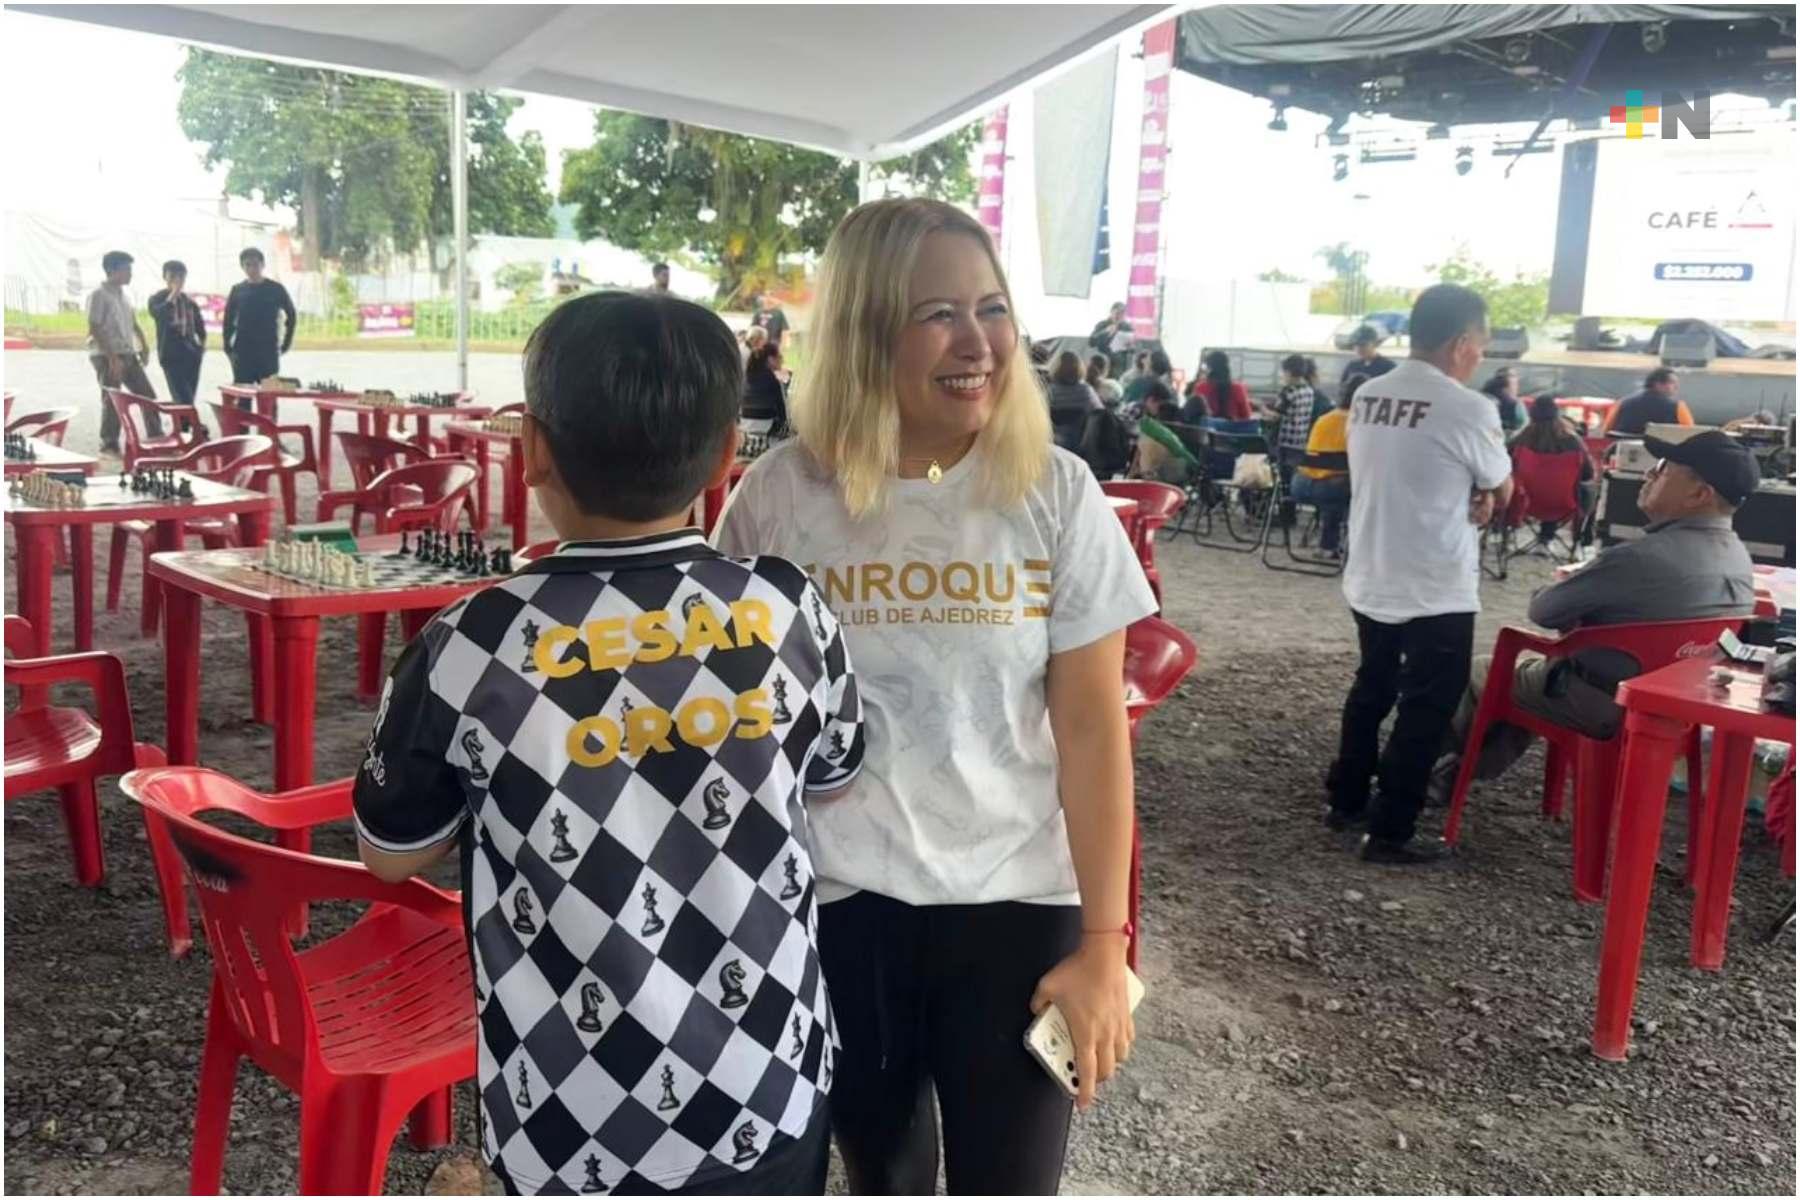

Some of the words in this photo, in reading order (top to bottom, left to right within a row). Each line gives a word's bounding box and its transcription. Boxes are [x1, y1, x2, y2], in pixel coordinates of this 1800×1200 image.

[1647, 204, 1719, 229] CAFÉ
[801, 559, 1051, 618] NROQUE
[832, 607, 880, 626] LUB
[886, 608, 914, 625] DE
[920, 606, 1015, 626] AJEDREZ
[532, 596, 777, 679] CESAR
[565, 687, 773, 768] OROS
